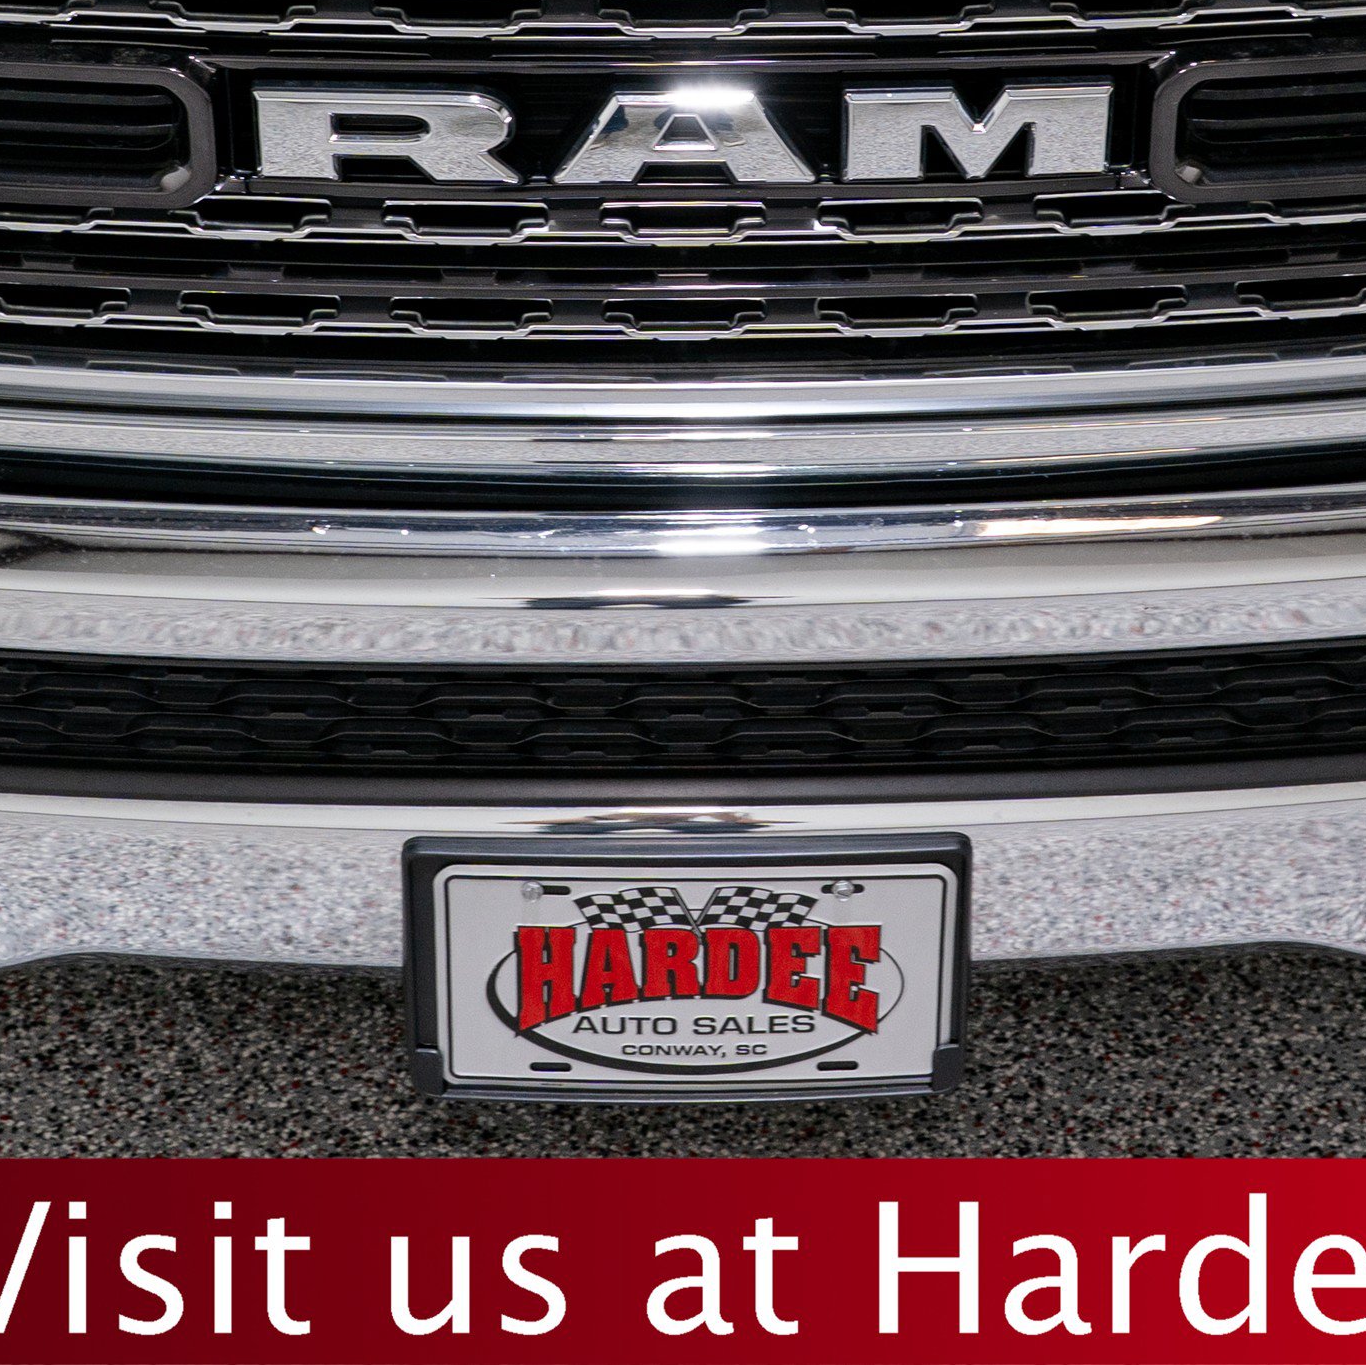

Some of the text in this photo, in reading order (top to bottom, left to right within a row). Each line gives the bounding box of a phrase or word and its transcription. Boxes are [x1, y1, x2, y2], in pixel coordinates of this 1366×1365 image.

[253, 85, 1115, 184] RAM
[514, 924, 882, 1034] HARDEE
[572, 1014, 816, 1035] AUTO SALES
[621, 1043, 767, 1058] CONWAY, SC
